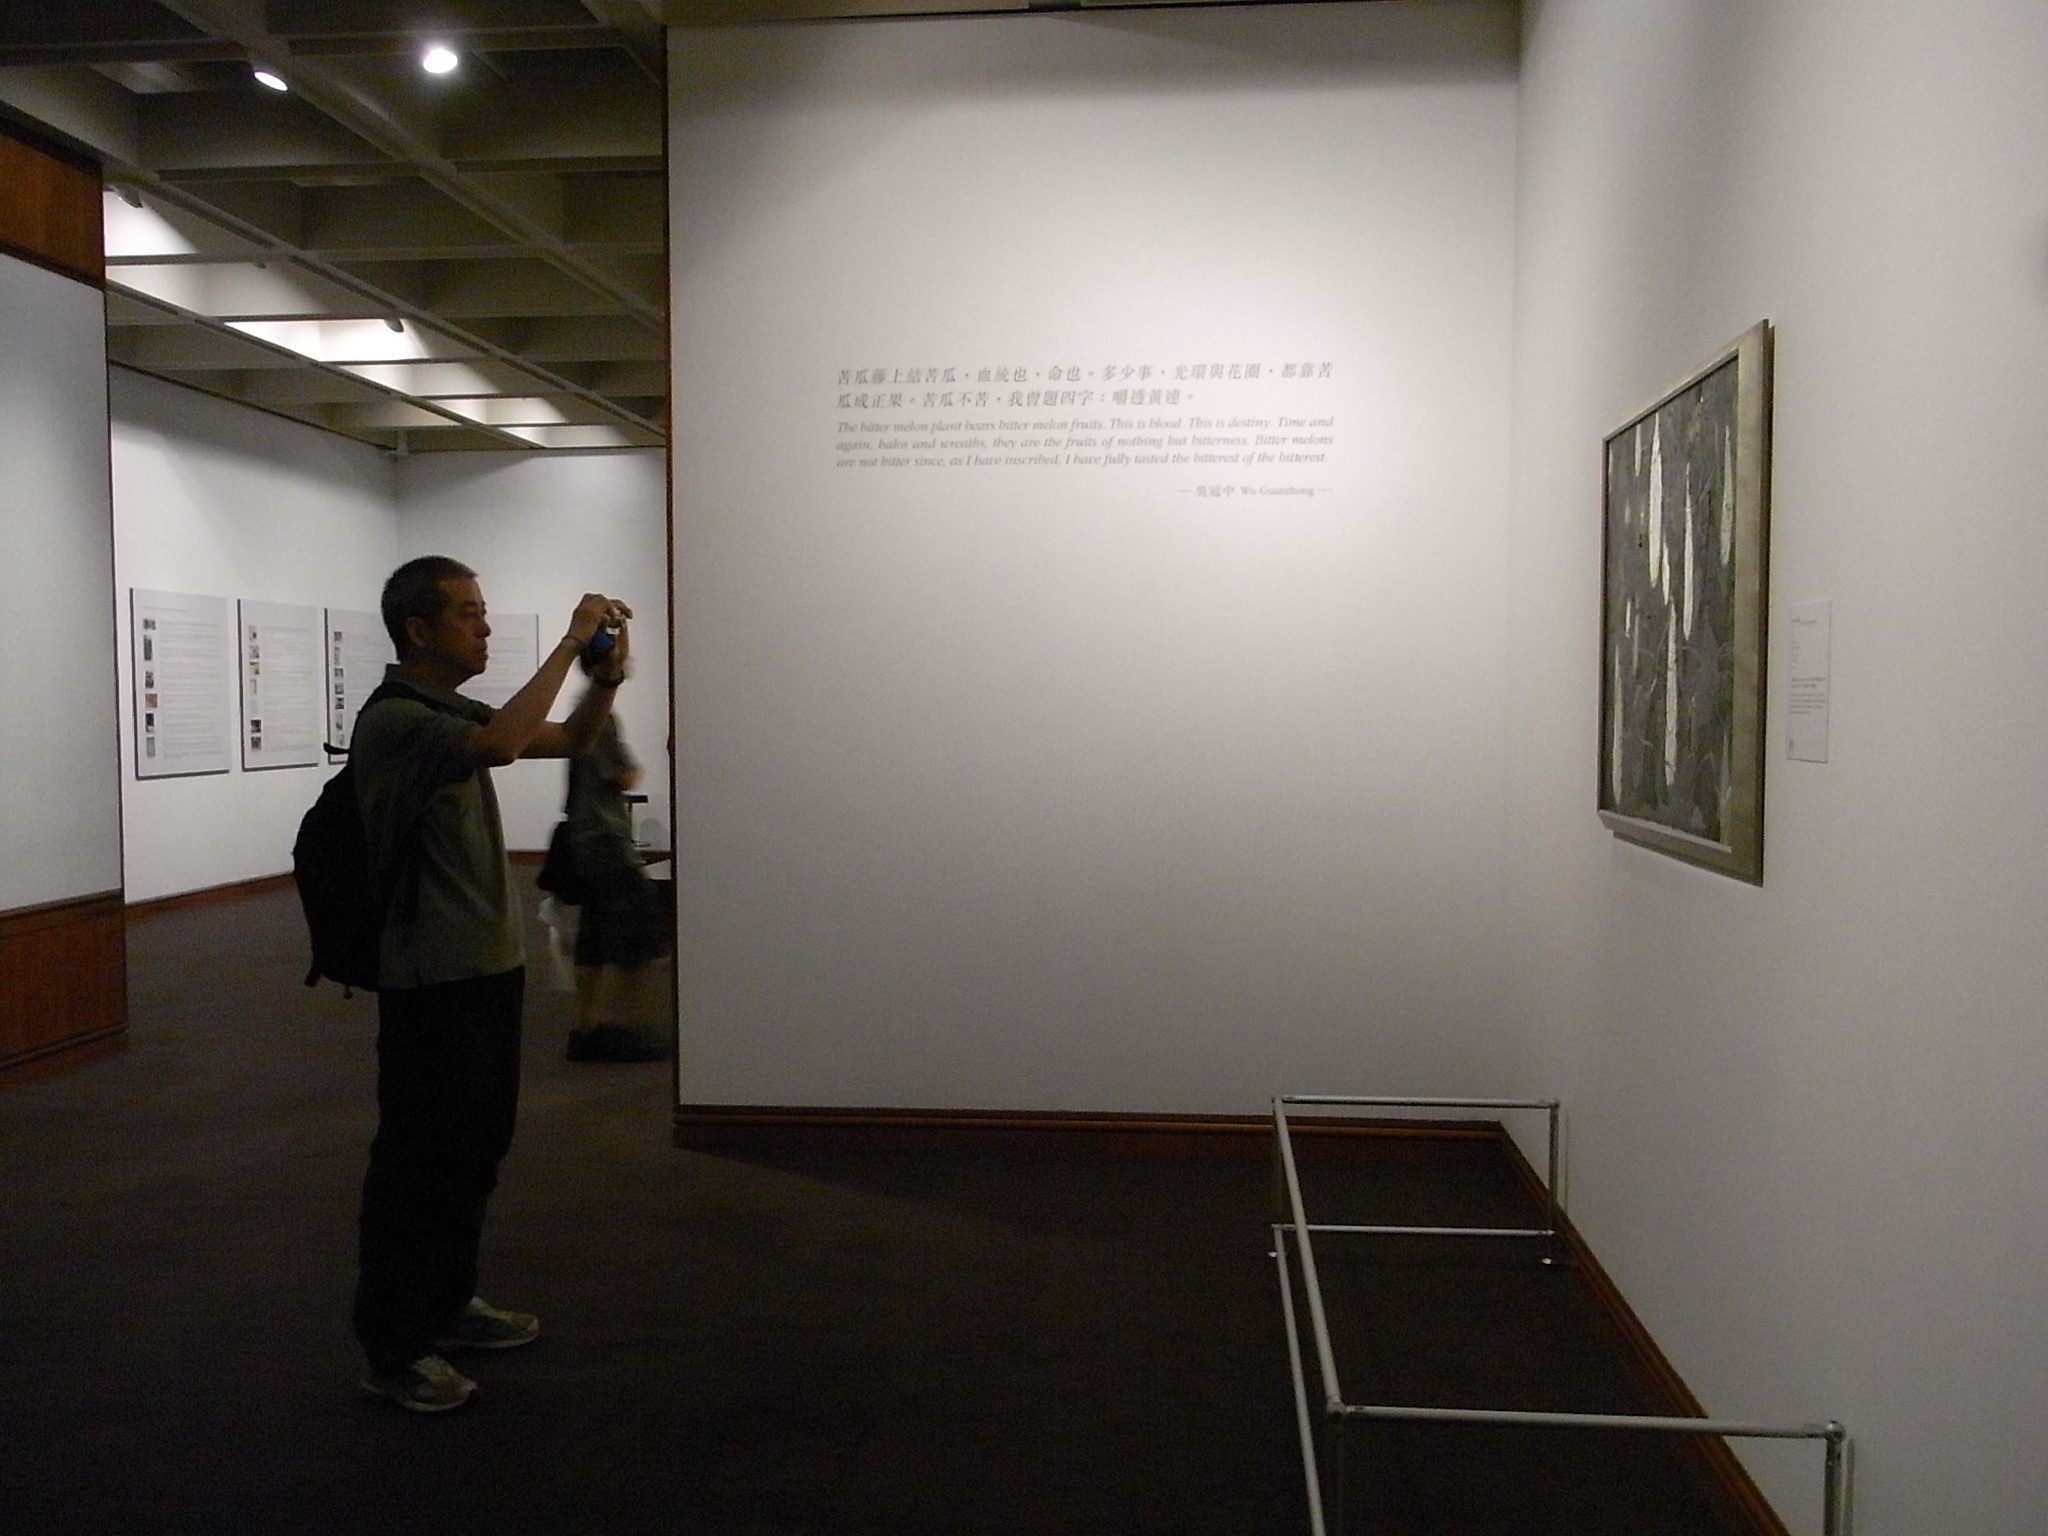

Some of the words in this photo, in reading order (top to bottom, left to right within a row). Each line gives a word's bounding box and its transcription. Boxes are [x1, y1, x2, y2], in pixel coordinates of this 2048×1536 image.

[838, 422, 857, 433] The
[860, 421, 889, 432] bitter
[893, 421, 928, 432] melon
[930, 421, 961, 434] plant
[965, 420, 995, 431] bears
[999, 420, 1028, 430] bitter
[1032, 419, 1067, 430] melon
[1110, 418, 1134, 429] This
[1137, 419, 1146, 429] is
[1188, 417, 1212, 428] This
[1216, 418, 1225, 428] is
[1277, 416, 1306, 428] Time
[1309, 416, 1334, 427] and
[878, 439, 908, 449] halos
[912, 438, 936, 449] and
[992, 437, 1017, 449] they
[1020, 439, 1040, 447] are
[1044, 437, 1063, 447] the
[1064, 436, 1097, 449] fruits
[1101, 435, 1115, 449] of
[1117, 436, 1163, 448] nothing
[1167, 435, 1187, 446] but
[1255, 434, 1288, 445] Bitter
[1291, 434, 1333, 445] melons
[836, 458, 856, 468] are
[859, 457, 878, 467] not
[881, 456, 911, 467] bitter
[950, 457, 962, 466] as
[974, 455, 1002, 466] have
[1073, 454, 1100, 464] have
[1102, 453, 1131, 467] fully
[1134, 453, 1168, 464] tasted
[1171, 453, 1190, 464] the
[1193, 452, 1239, 463] bitterest
[1242, 451, 1257, 465] of
[1257, 452, 1275, 463] the
[1240, 485, 1257, 496] Wu
[1259, 485, 1314, 497] Guanzhong
